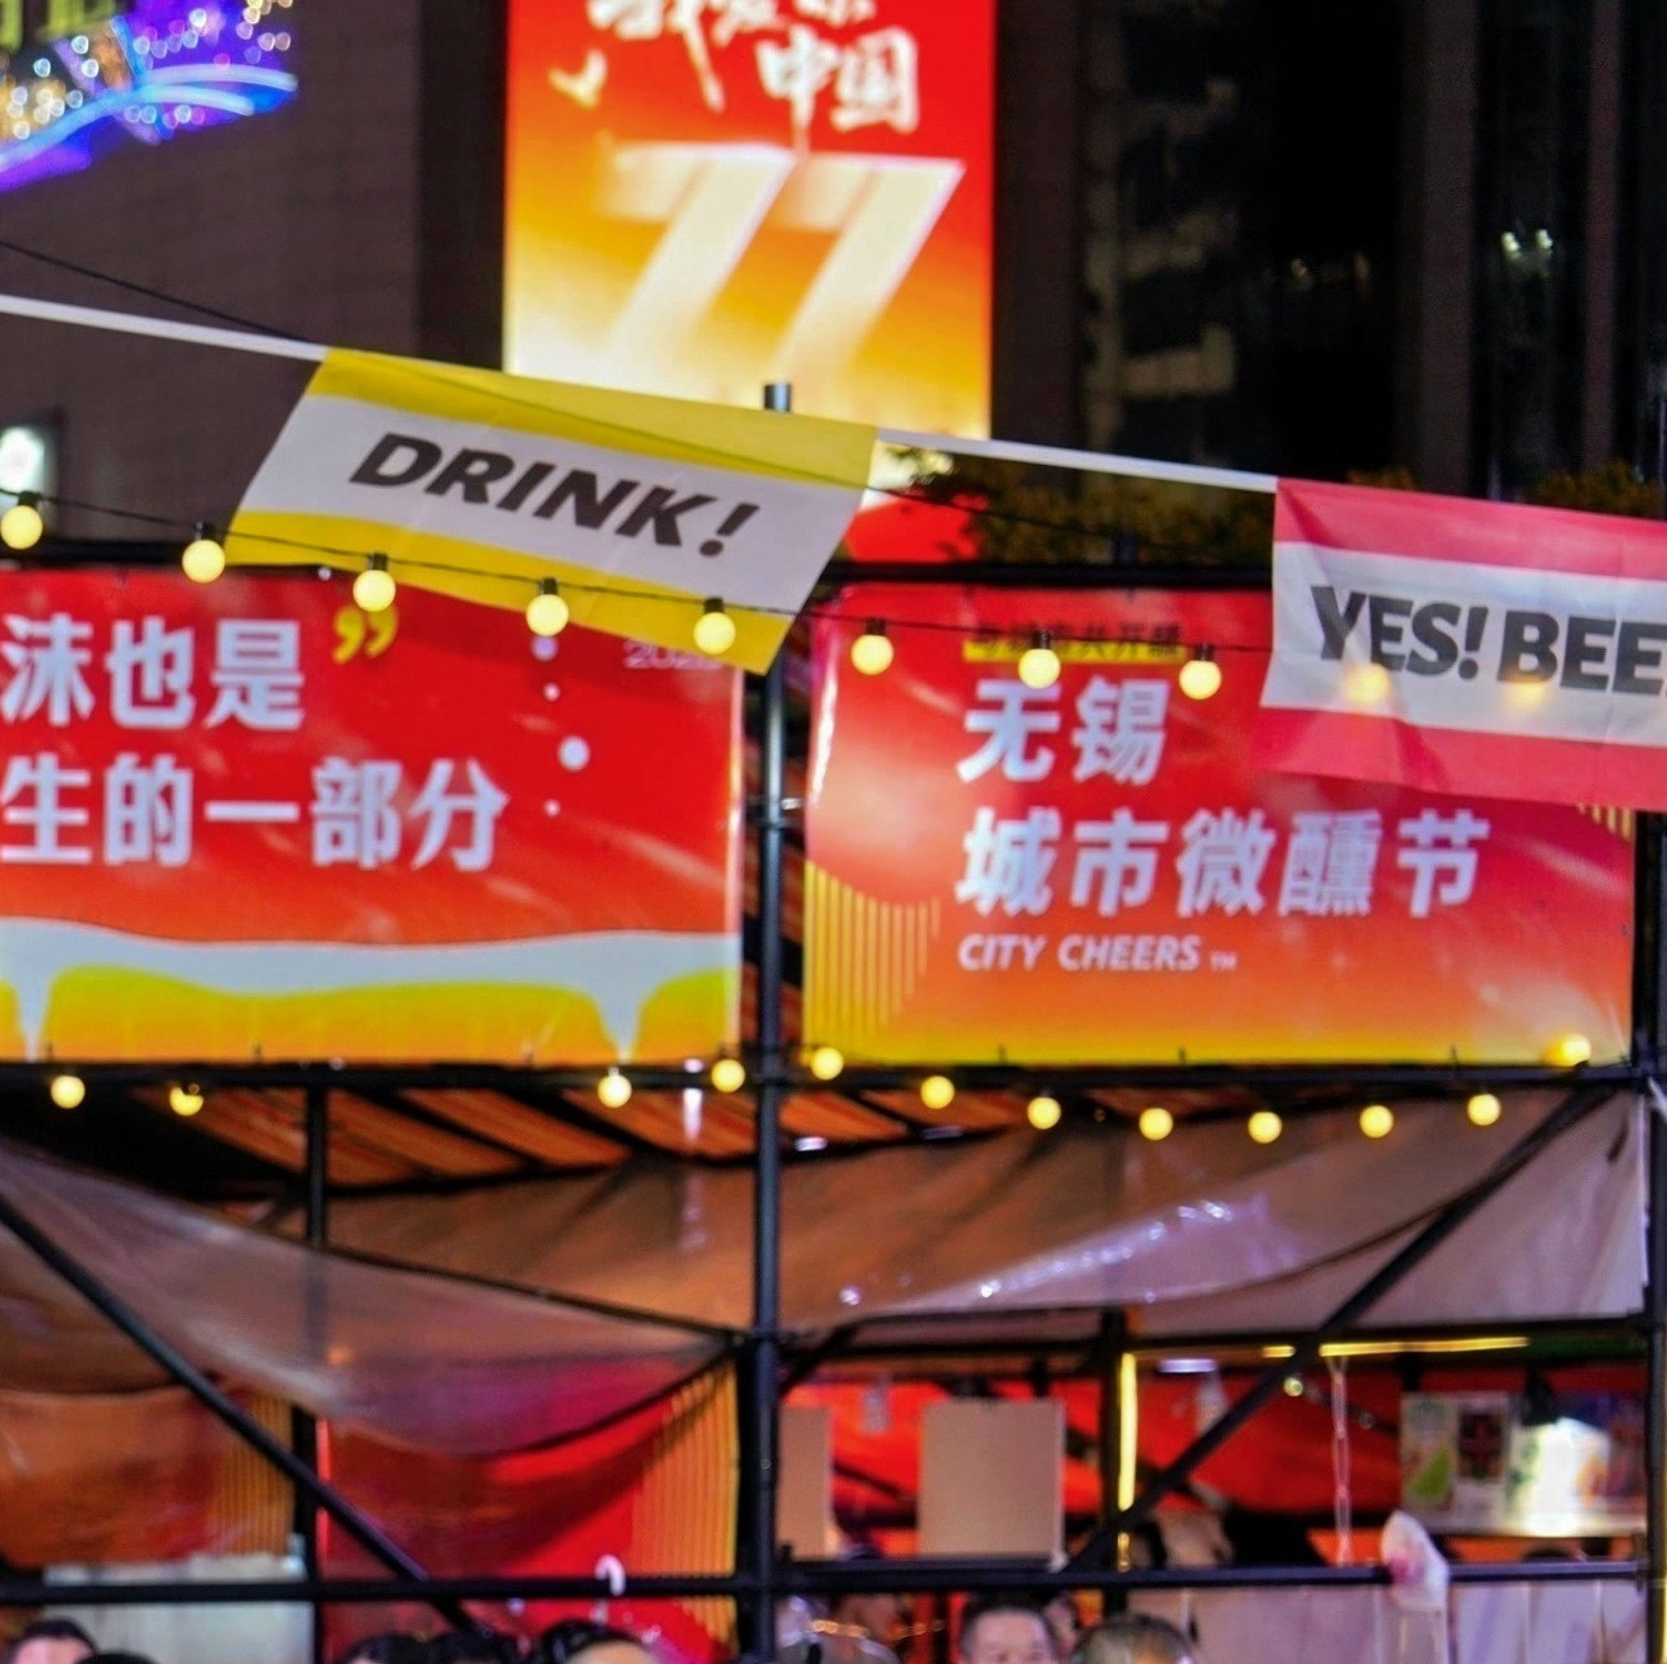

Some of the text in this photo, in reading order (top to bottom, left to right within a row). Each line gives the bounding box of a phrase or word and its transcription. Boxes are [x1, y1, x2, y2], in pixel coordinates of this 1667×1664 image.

[755, 24, 920, 150] 中国
[597, 141, 966, 372] 77
[350, 431, 760, 559] DRINK!
[1311, 585, 1667, 696] YES! BEE
[957, 676, 1170, 788] 无锡
[955, 805, 1491, 919] 城市微醺节
[957, 933, 1048, 971] CITY
[1057, 933, 1202, 972] CHEERS
